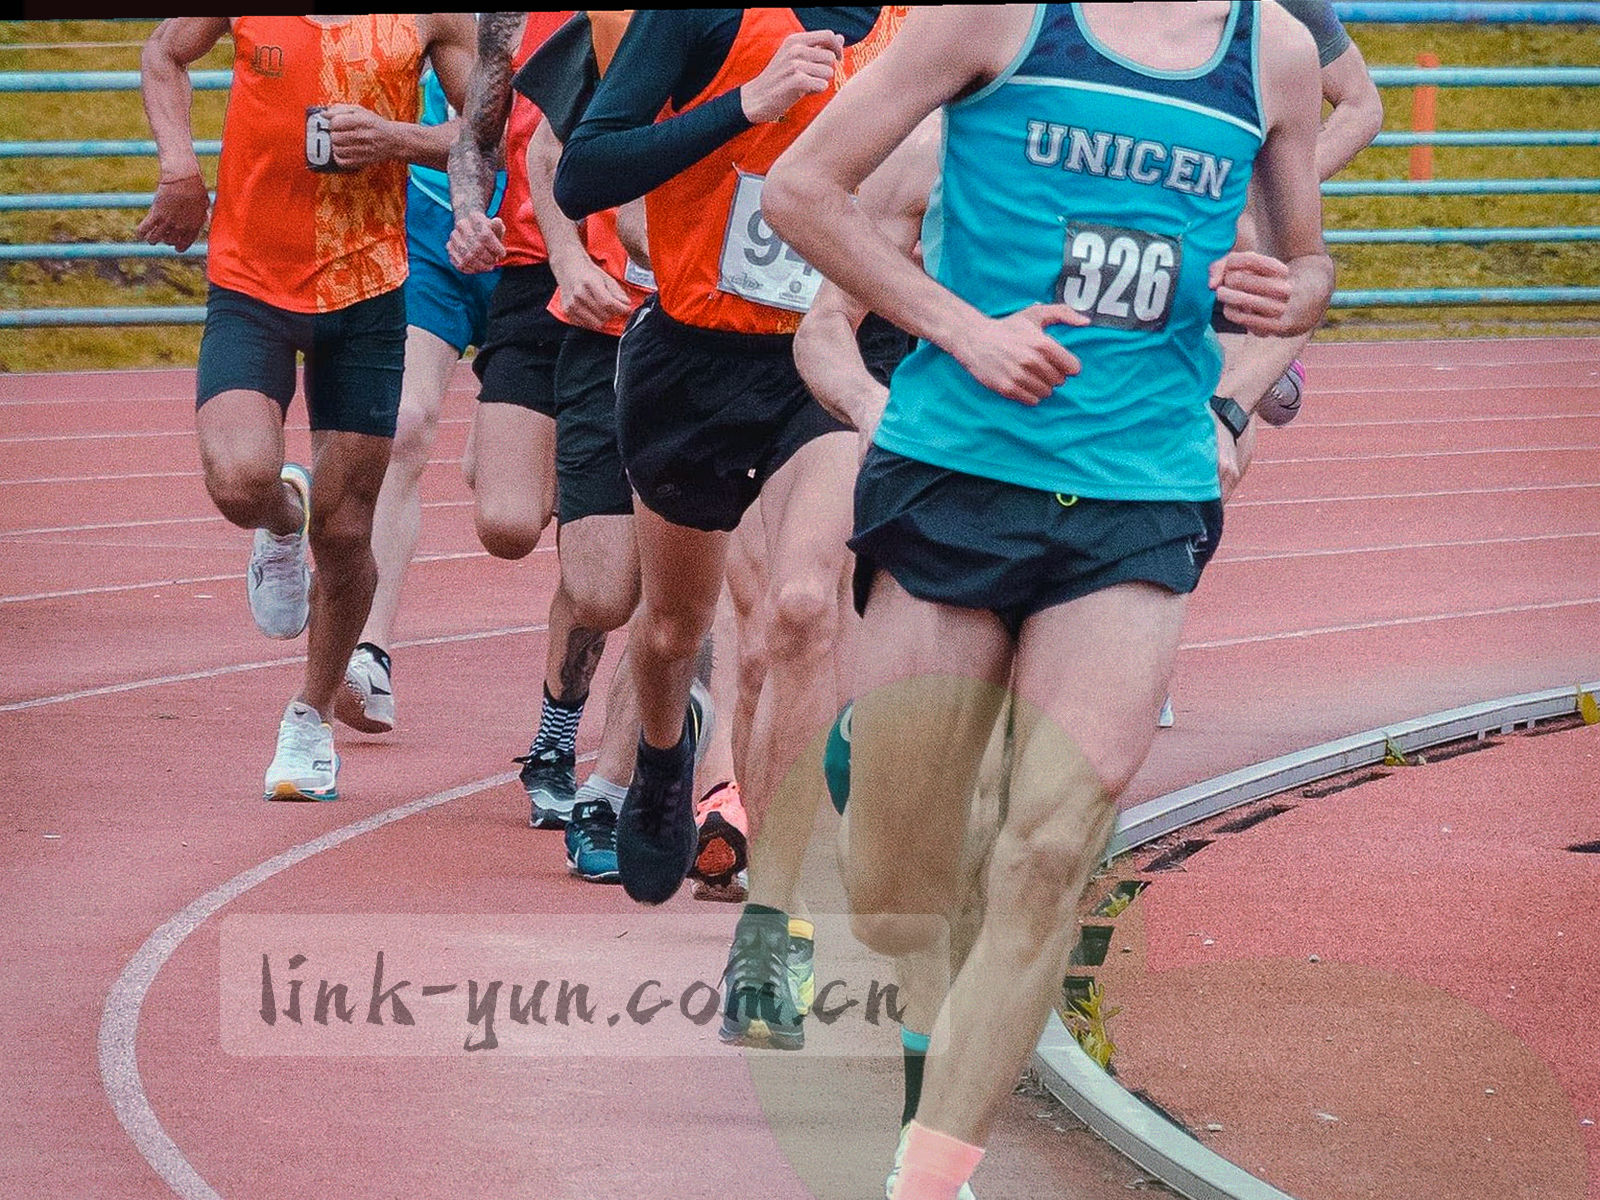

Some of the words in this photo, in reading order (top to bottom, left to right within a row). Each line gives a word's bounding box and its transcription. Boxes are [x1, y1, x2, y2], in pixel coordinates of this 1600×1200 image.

[306, 112, 331, 166] 6
[1024, 119, 1233, 200] UNICEN
[1063, 231, 1174, 322] 326
